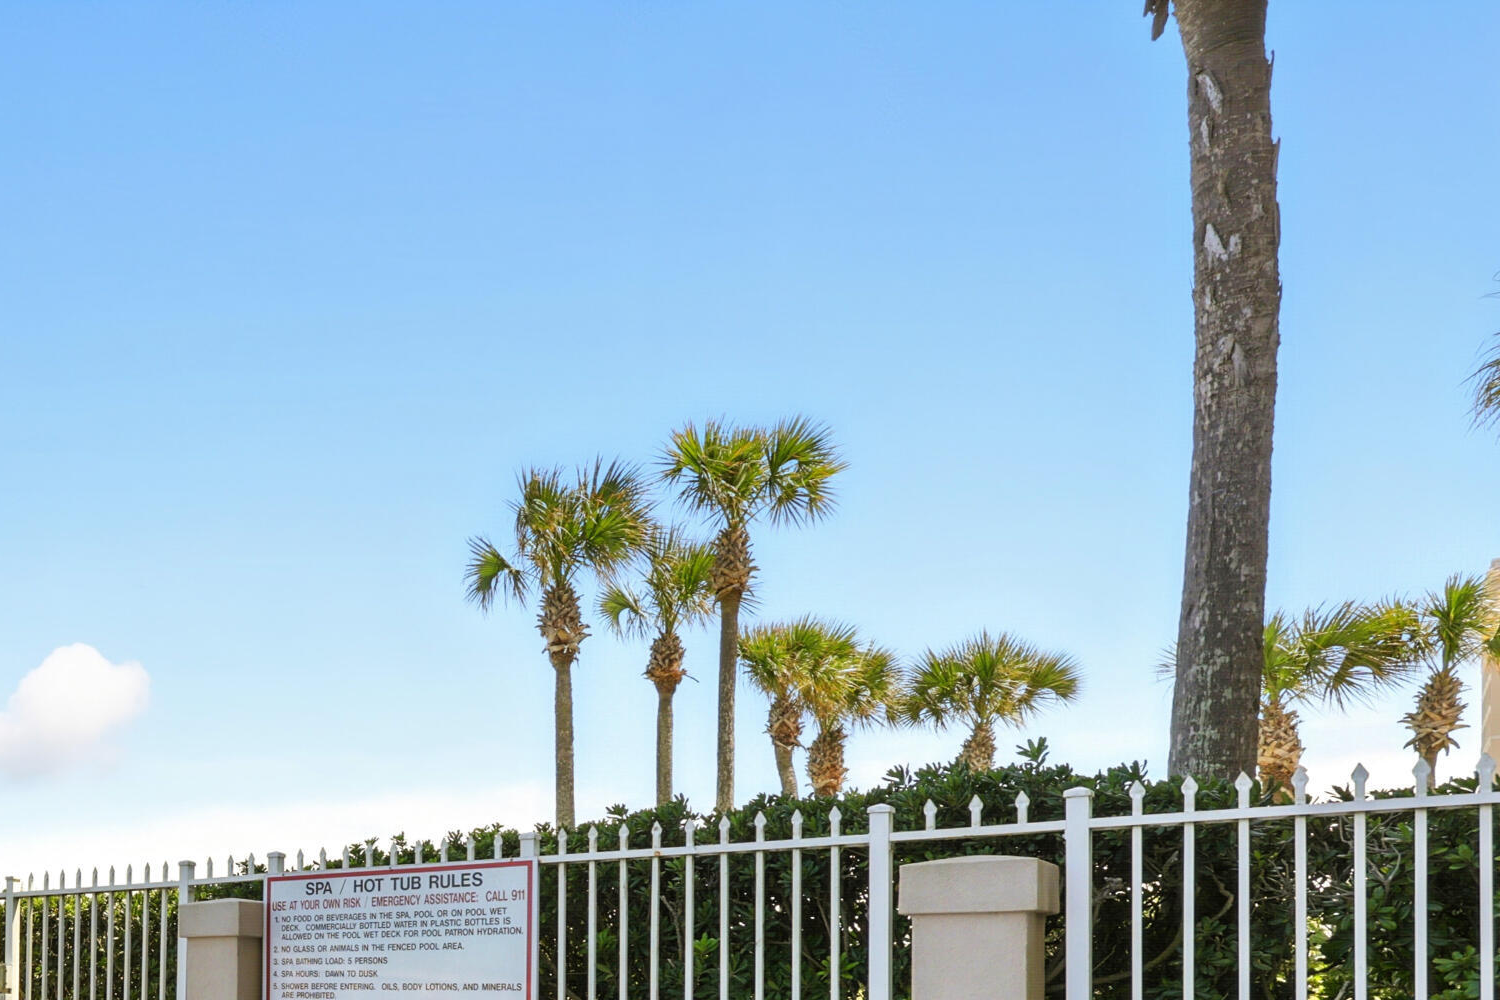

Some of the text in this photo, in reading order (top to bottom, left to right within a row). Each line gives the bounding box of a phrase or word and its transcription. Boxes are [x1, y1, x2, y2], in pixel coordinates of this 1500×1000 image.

[304, 880, 333, 896] SPA
[352, 877, 384, 893] HOT
[390, 875, 421, 891] TUB
[428, 871, 483, 889] RULES
[272, 900, 287, 911] USE
[288, 900, 298, 910] AT
[299, 898, 320, 910] YOUR
[322, 897, 340, 909] OWN
[342, 896, 361, 909] RISK
[371, 893, 421, 907] EMERGENCY
[423, 890, 478, 905] ASSISTANCE:
[485, 889, 508, 902] CALL
[510, 888, 524, 901] 911
[281, 915, 291, 923] NO
[292, 914, 312, 923] FOOD
[313, 913, 324, 922] OR
[325, 912, 367, 922] BEVERAGES
[369, 912, 376, 920] IN
[378, 911, 393, 920] THE
[413, 909, 434, 919] POOL
[436, 909, 448, 918] OR
[450, 908, 462, 917] ON
[465, 907, 487, 916] POOL
[488, 906, 507, 915] WET
[305, 921, 356, 931] COMMERCIALLY
[359, 920, 391, 929] BOTTLED
[393, 920, 417, 928] WATER
[420, 919, 427, 927] IN
[430, 917, 461, 928] PLASTIC
[464, 916, 500, 926] BOTTLES
[502, 916, 511, 925] IS
[281, 925, 523, 941] ALLOWED ON THE POOL WET DECK FOR POOL PATRON HYDRATION.
[280, 945, 291, 953] NO
[292, 944, 315, 953] GLASS
[316, 944, 327, 952] OR
[329, 943, 359, 952] ANIMALS
[361, 943, 369, 951] IN
[370, 943, 385, 951] THE
[387, 942, 417, 951] FENCED
[418, 942, 440, 951] POOL
[441, 941, 464, 950] AREA.
[280, 957, 293, 965] SPA
[295, 957, 323, 965] BATHING
[324, 956, 345, 965] LOAD:
[347, 956, 352, 965] 5
[354, 956, 388, 965] PERSONS
[324, 969, 345, 977] DAWN
[346, 969, 356, 977] TO
[358, 969, 378, 978] DUSK
[280, 982, 309, 990] SHOWER
[310, 982, 338, 990] BEFORE
[401, 982, 423, 991] BODY
[425, 982, 459, 992] LOTIONS,
[461, 982, 479, 991] AND
[481, 982, 522, 992] MINERALS
